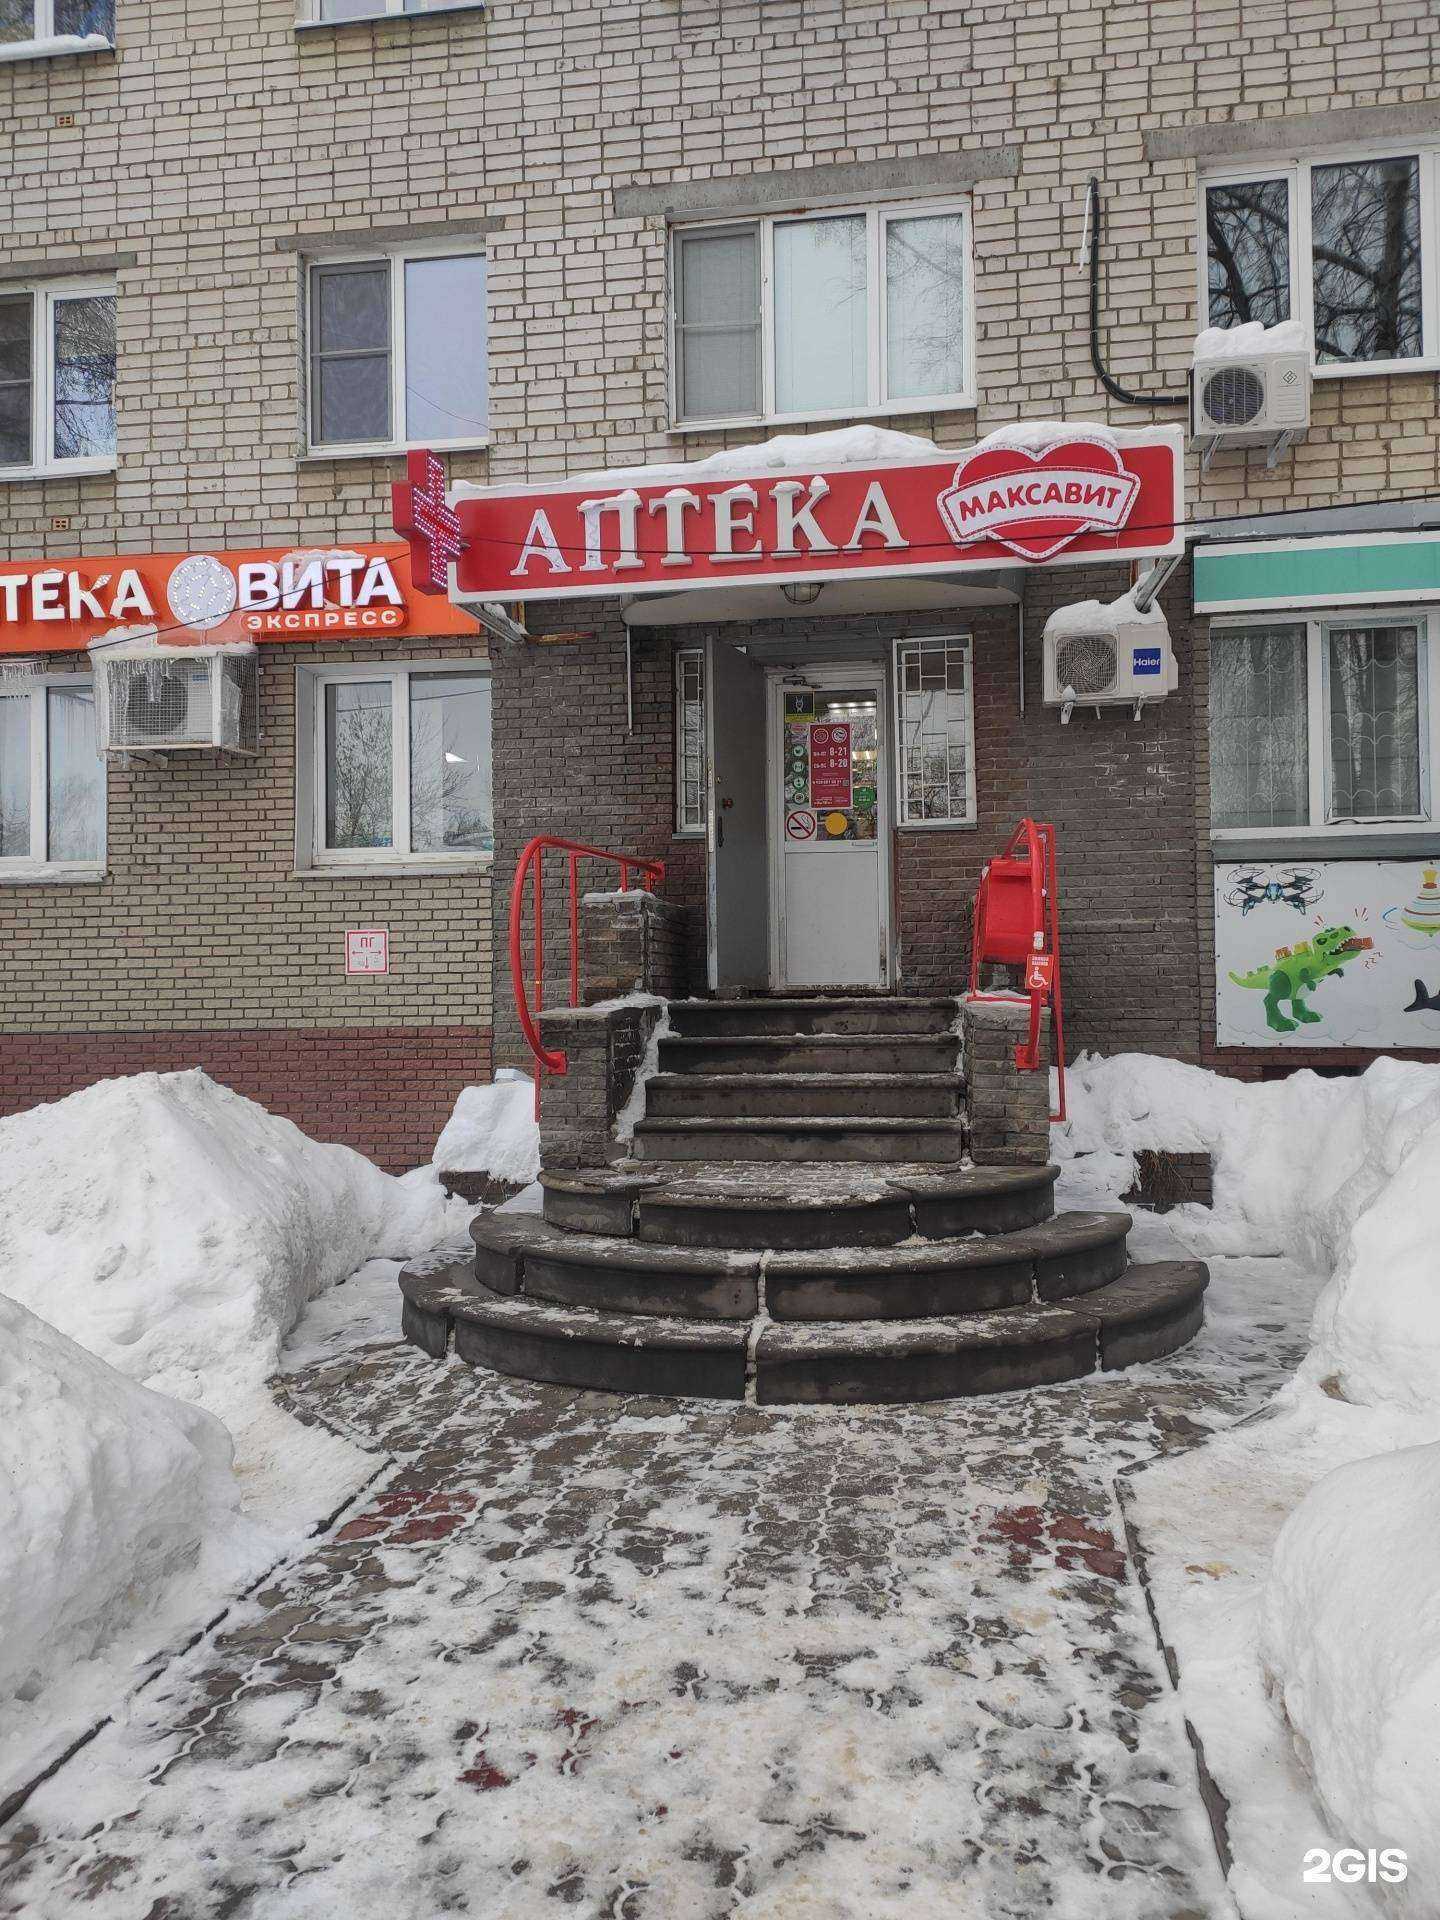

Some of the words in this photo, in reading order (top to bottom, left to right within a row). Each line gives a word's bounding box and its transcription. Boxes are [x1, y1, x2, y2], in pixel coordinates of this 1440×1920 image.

[959, 483, 1122, 521] МАКСАВИТ
[510, 477, 910, 576] АПТЕКА
[238, 556, 402, 611] ВИТА
[246, 609, 398, 630] ЭКСПРЕСС
[1133, 658, 1160, 667] Haier
[360, 937, 375, 948] ПГ
